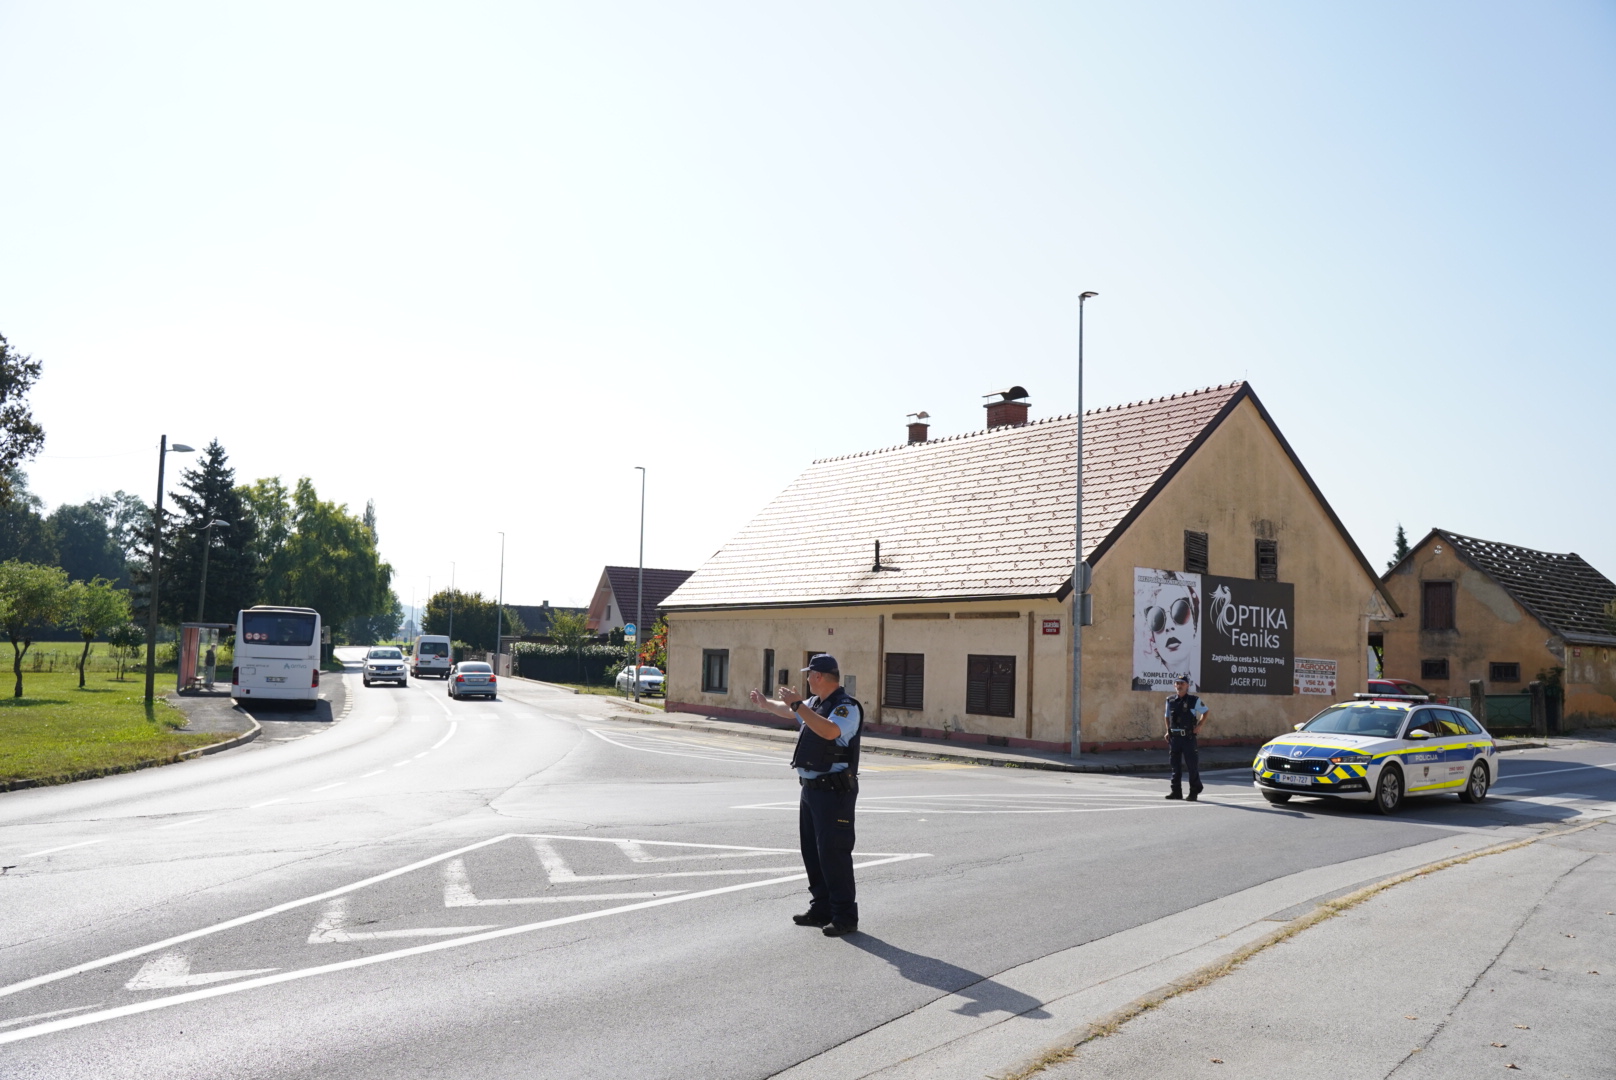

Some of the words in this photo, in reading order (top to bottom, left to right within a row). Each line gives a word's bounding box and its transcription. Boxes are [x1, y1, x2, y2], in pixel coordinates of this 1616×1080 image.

[1224, 604, 1288, 630] OPTIKA
[1232, 628, 1280, 649] Feniks
[1211, 654, 1238, 663] Zagrebška
[1275, 657, 1285, 666] Ptuj
[1230, 678, 1251, 686] JAGER
[1252, 678, 1267, 687] PTUJ
